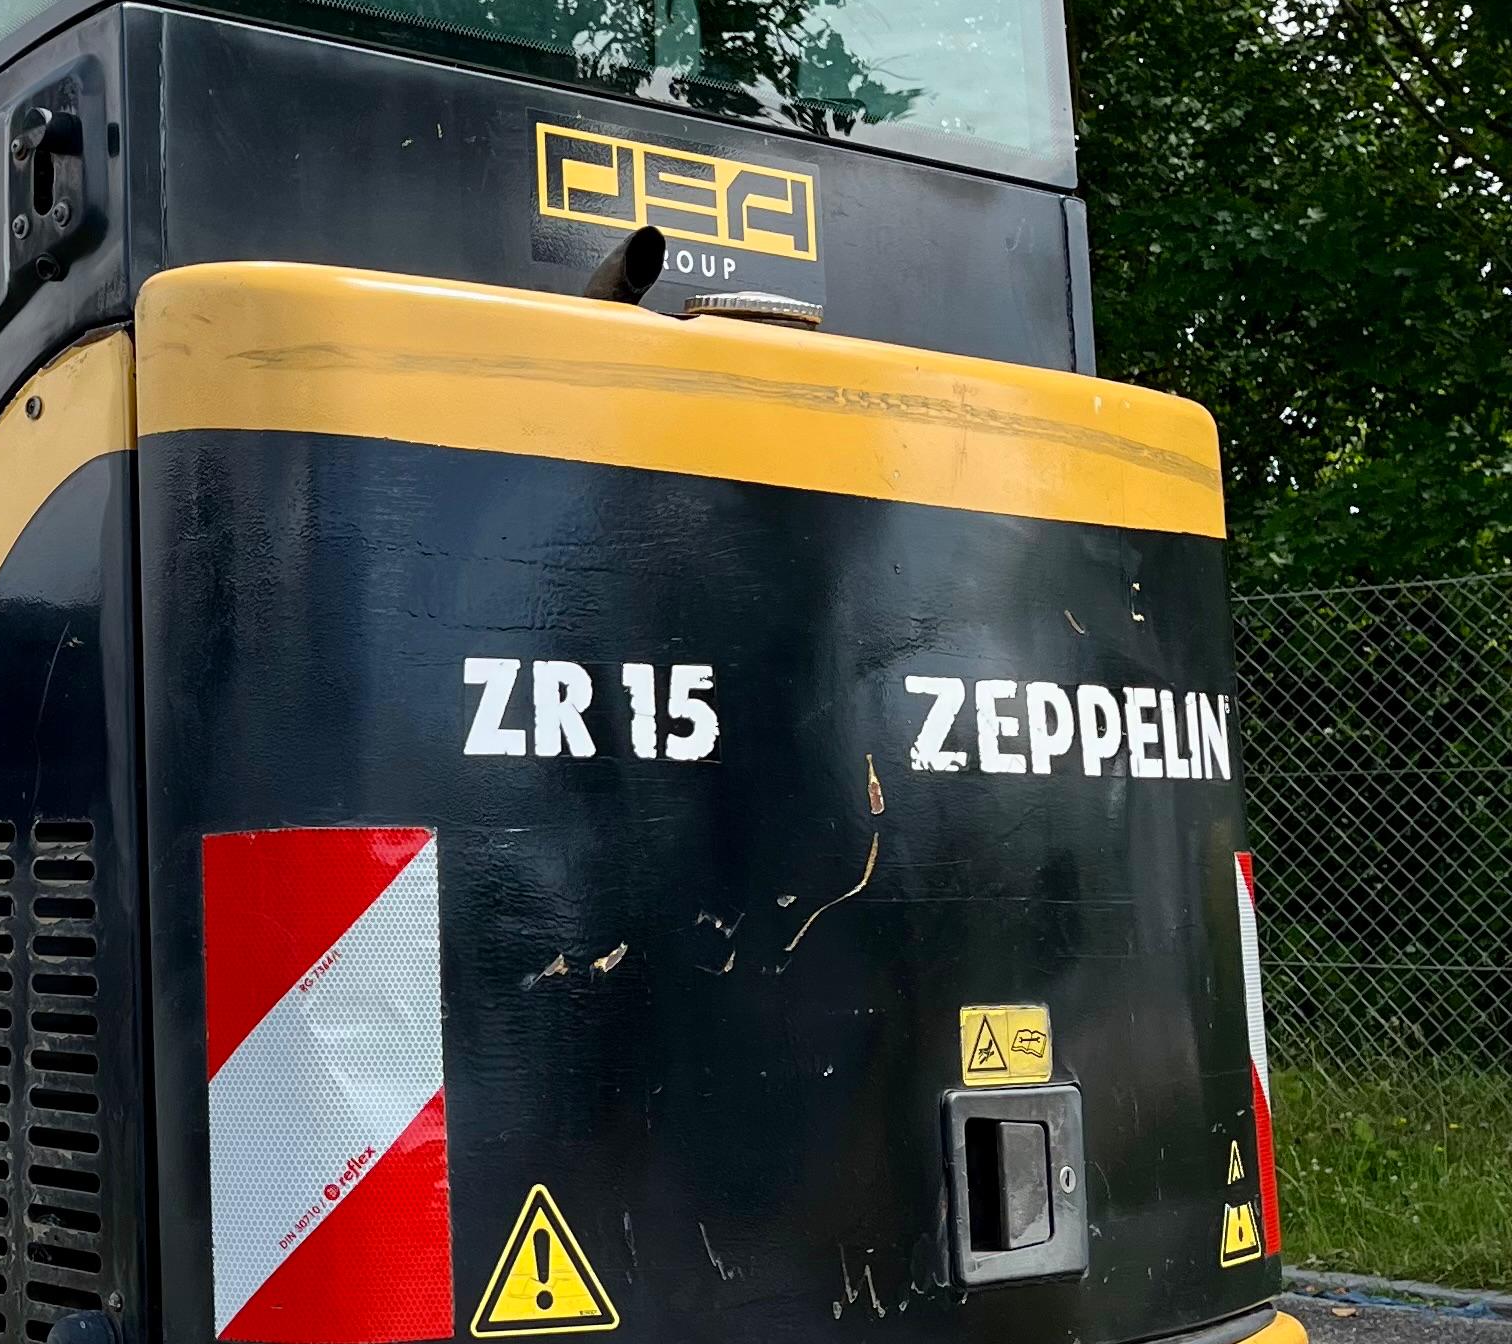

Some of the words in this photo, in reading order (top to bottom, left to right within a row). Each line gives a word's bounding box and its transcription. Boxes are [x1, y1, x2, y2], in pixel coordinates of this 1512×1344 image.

[663, 247, 737, 281] OUP
[463, 657, 596, 757] ZR
[622, 663, 720, 760] 15
[904, 675, 1231, 780] ZEPPELIN
[278, 1231, 297, 1250] DIN
[294, 1205, 321, 1233] 30710
[339, 1145, 377, 1187] reflex
